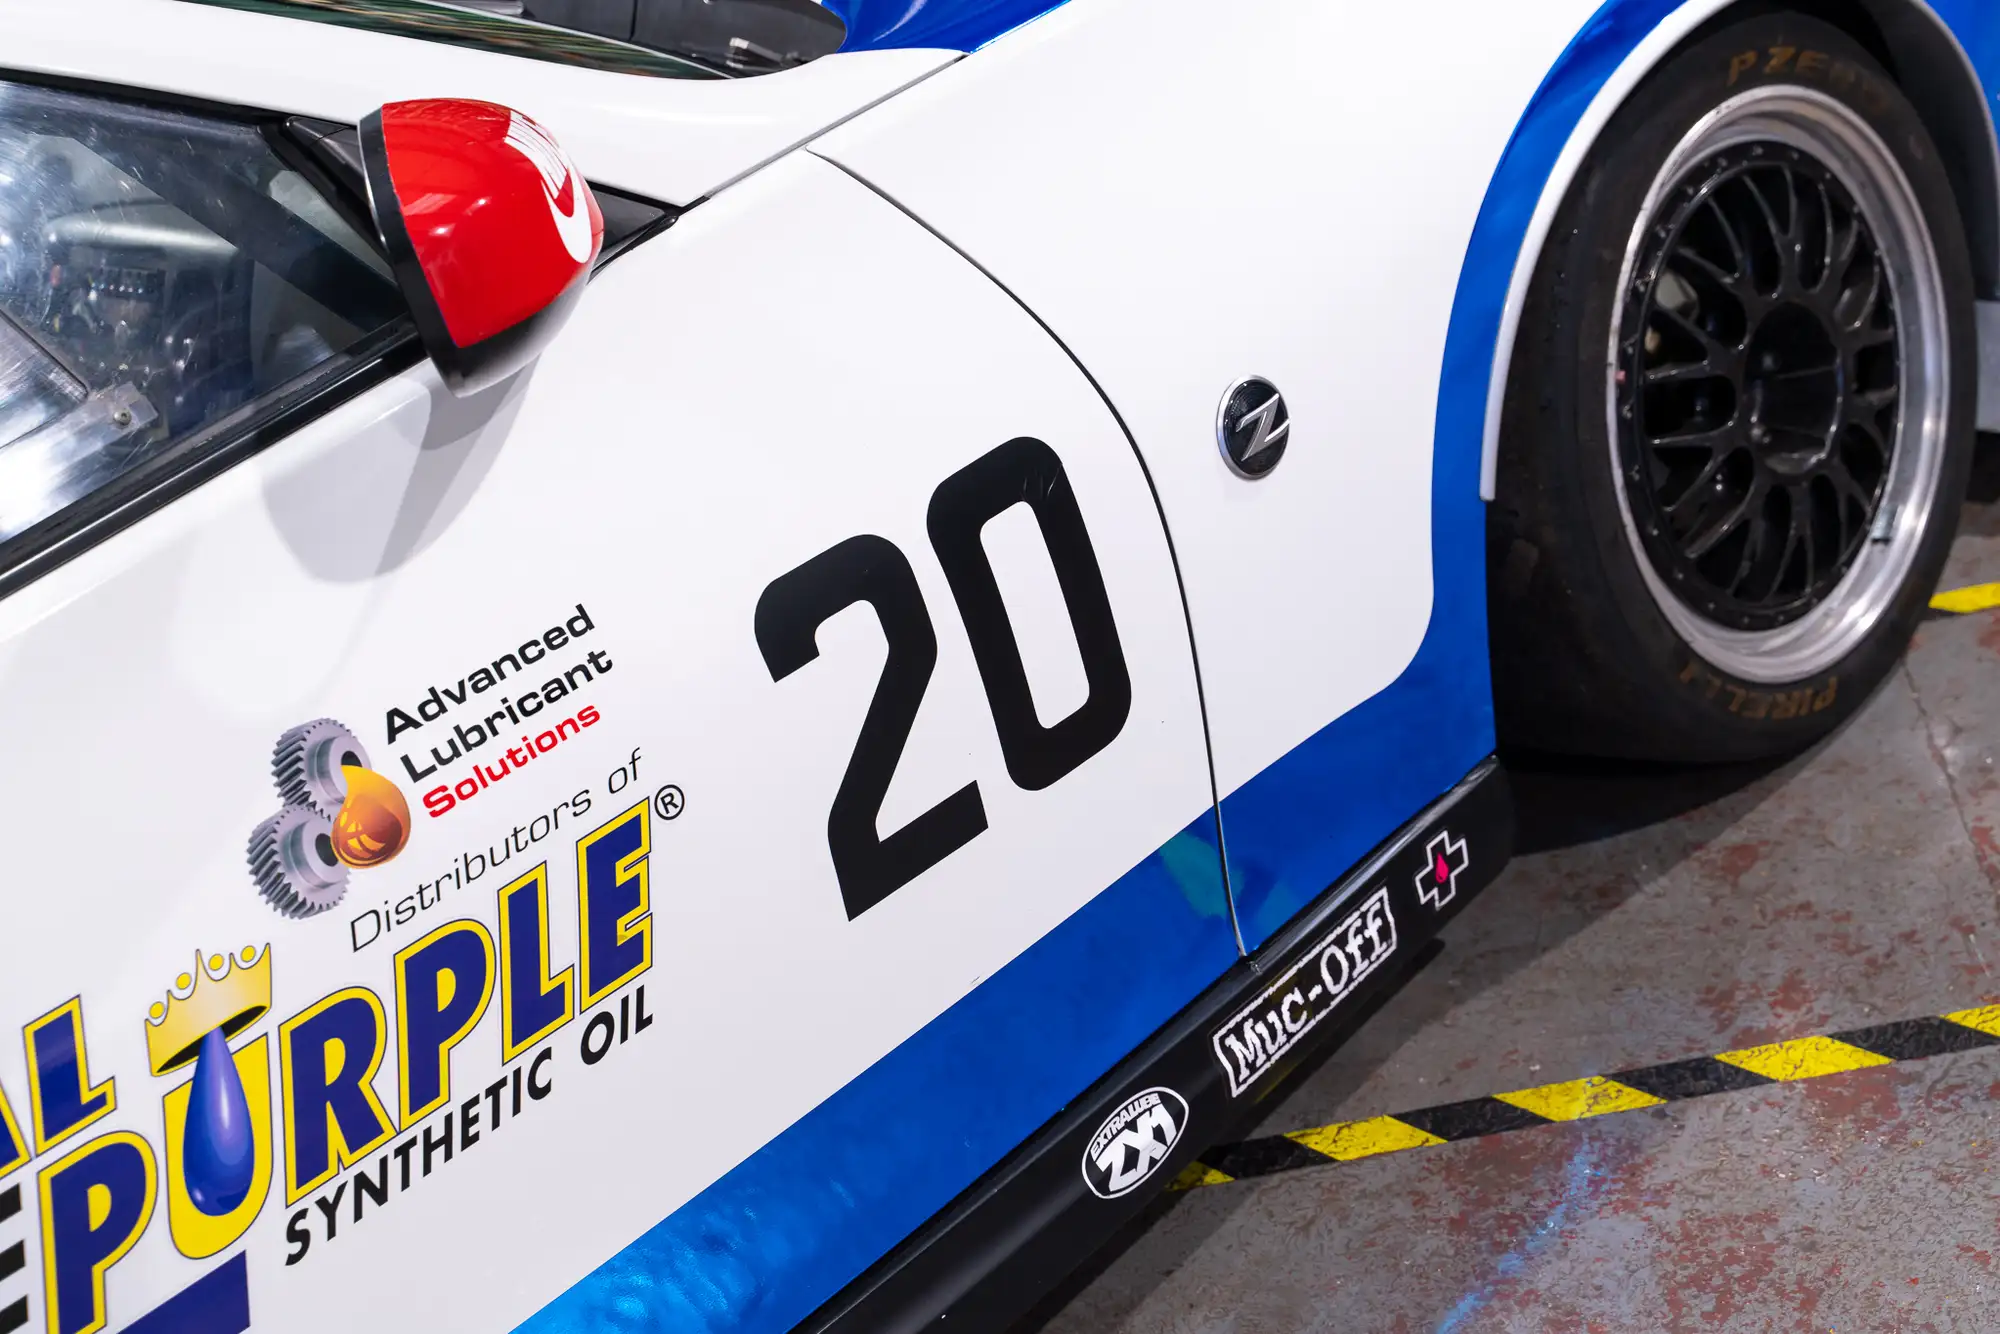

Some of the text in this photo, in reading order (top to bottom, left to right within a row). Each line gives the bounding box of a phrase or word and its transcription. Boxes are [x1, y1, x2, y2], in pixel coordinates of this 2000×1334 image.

[385, 603, 596, 745] Advanced
[400, 649, 613, 783] Lubricant
[754, 436, 1132, 922] 20
[422, 704, 601, 818] Solutions
[349, 747, 642, 953] Distributors of
[285, 984, 653, 1266] SYNTHETIC OIL
[1090, 1092, 1162, 1162] EXTRALUBE
